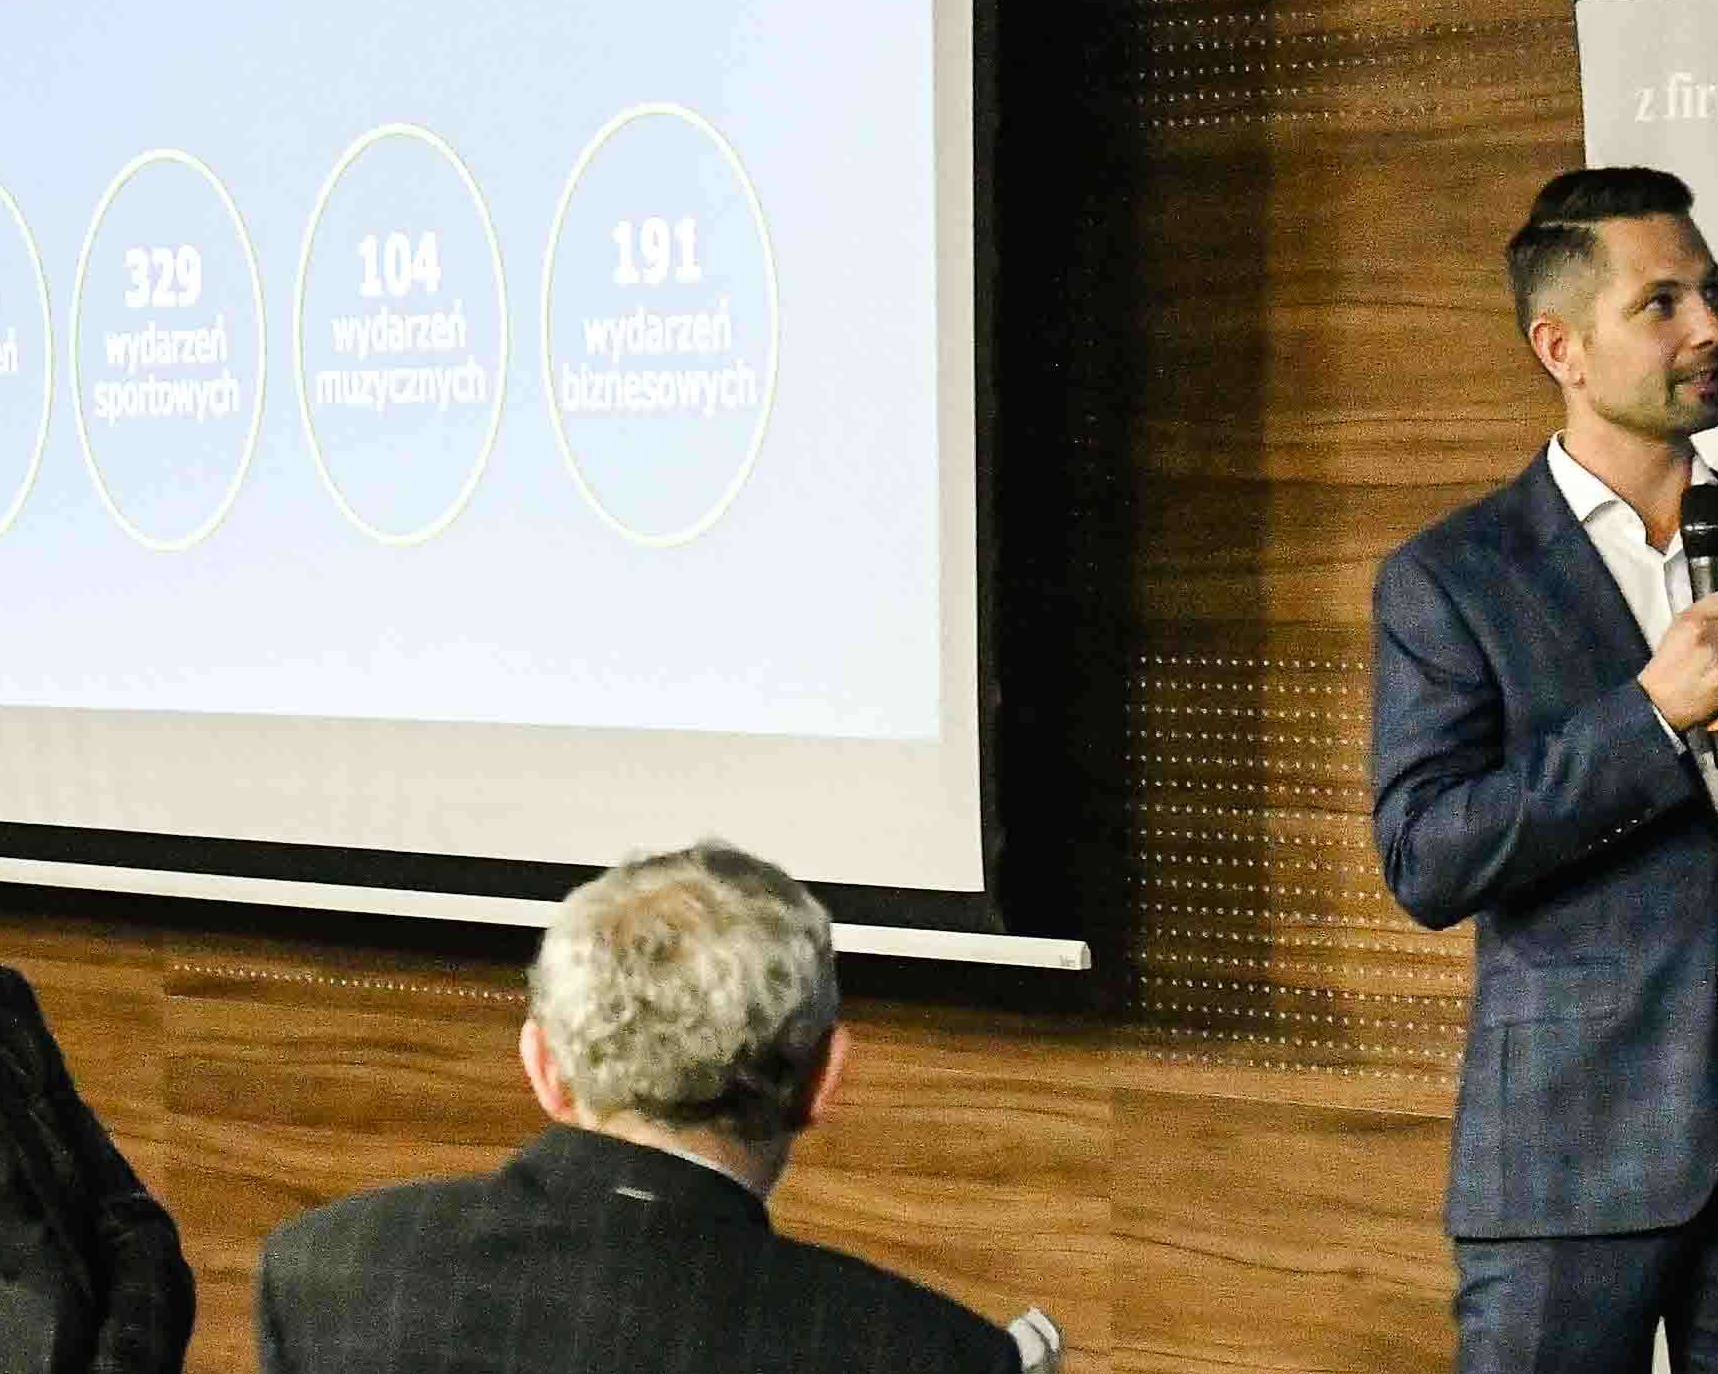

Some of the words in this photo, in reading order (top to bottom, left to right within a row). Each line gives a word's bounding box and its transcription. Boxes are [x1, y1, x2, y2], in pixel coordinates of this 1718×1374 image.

[1634, 85, 1657, 123] z
[123, 244, 202, 309] 329
[357, 228, 444, 298] 104
[611, 213, 706, 288] 191
[105, 308, 228, 376] wydarzeń
[331, 298, 467, 362] wydarzeń
[583, 294, 732, 364] wydarzeń
[92, 367, 239, 426] sportowych
[315, 355, 487, 412] muzycznych
[561, 357, 757, 419] biznesowych
